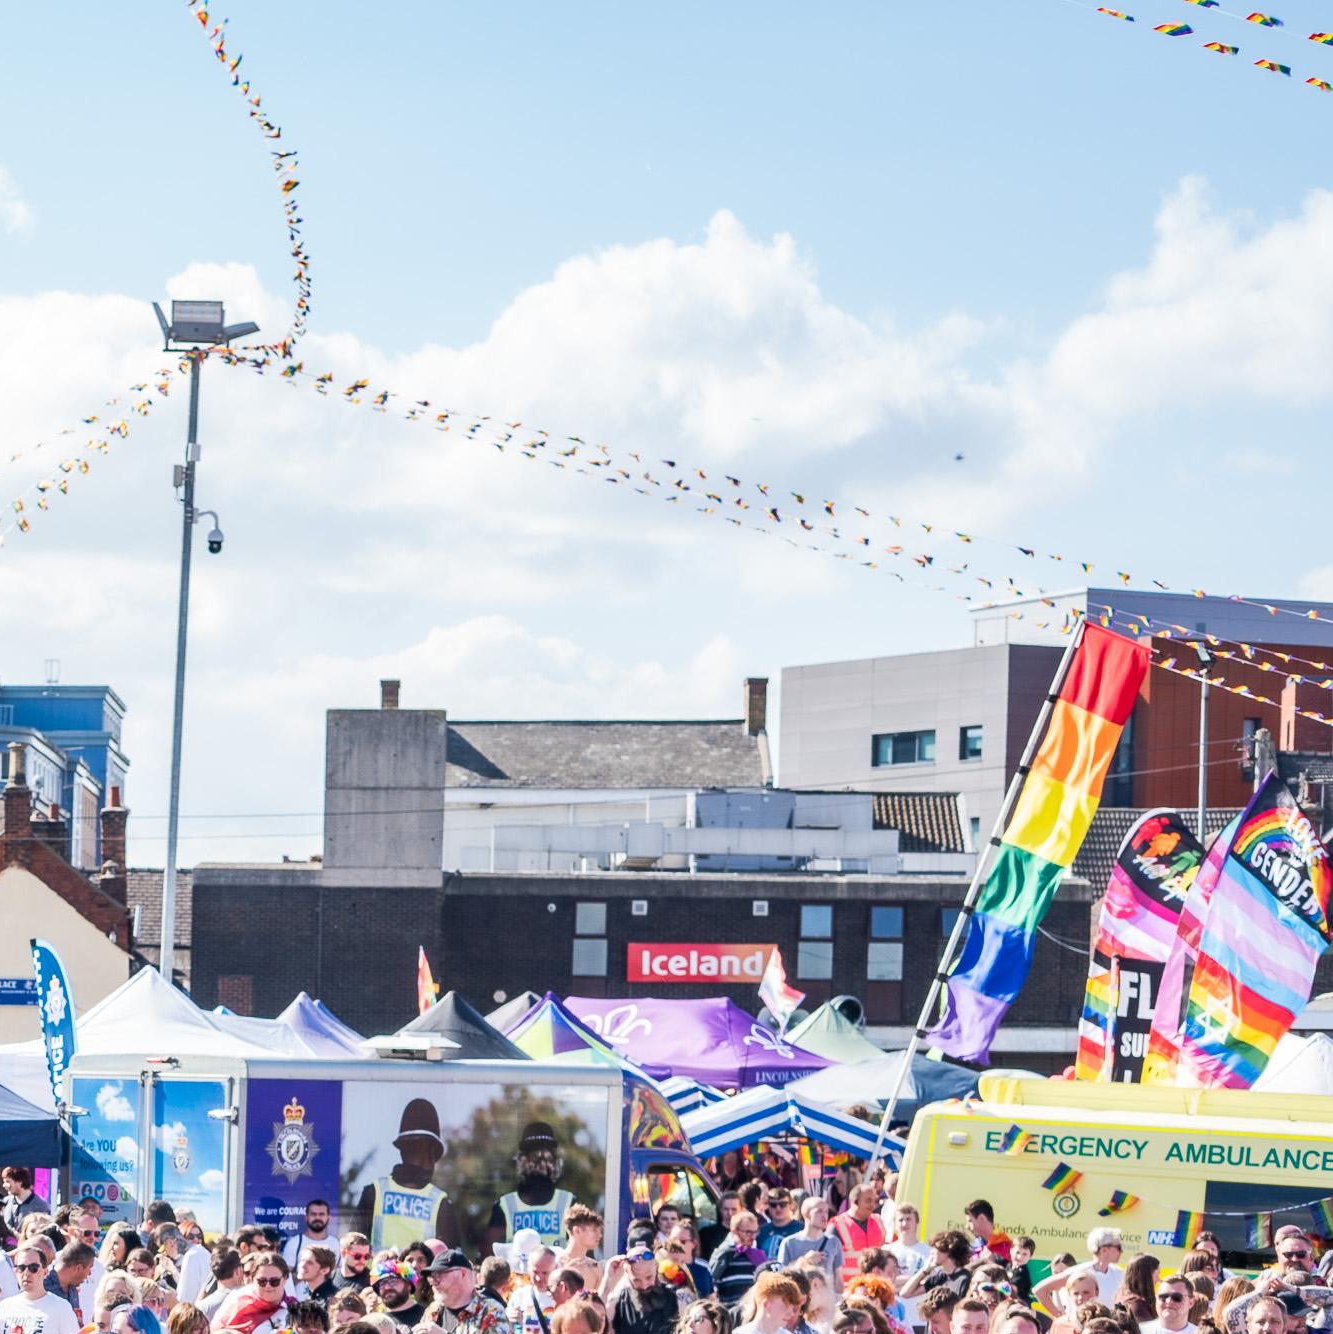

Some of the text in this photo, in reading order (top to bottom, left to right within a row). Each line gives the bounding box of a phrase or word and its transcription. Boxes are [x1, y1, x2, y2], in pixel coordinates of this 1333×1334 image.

[641, 950, 764, 976] Iceland
[1118, 970, 1154, 1021] FL
[51, 1033, 64, 1098] OLICE
[97, 1140, 116, 1151] YOU
[986, 1131, 1333, 1172] EERGENCY AMBULANCE
[119, 1160, 133, 1172] us?
[254, 1206, 265, 1216] We
[267, 1208, 278, 1216] are
[384, 1193, 432, 1217] POLICE
[278, 1222, 298, 1230] OPEN
[514, 1214, 559, 1232] POLICE
[947, 1220, 968, 1230] Eas
[1032, 1226, 1088, 1241] Ambulanc
[1120, 1233, 1142, 1243] vice
